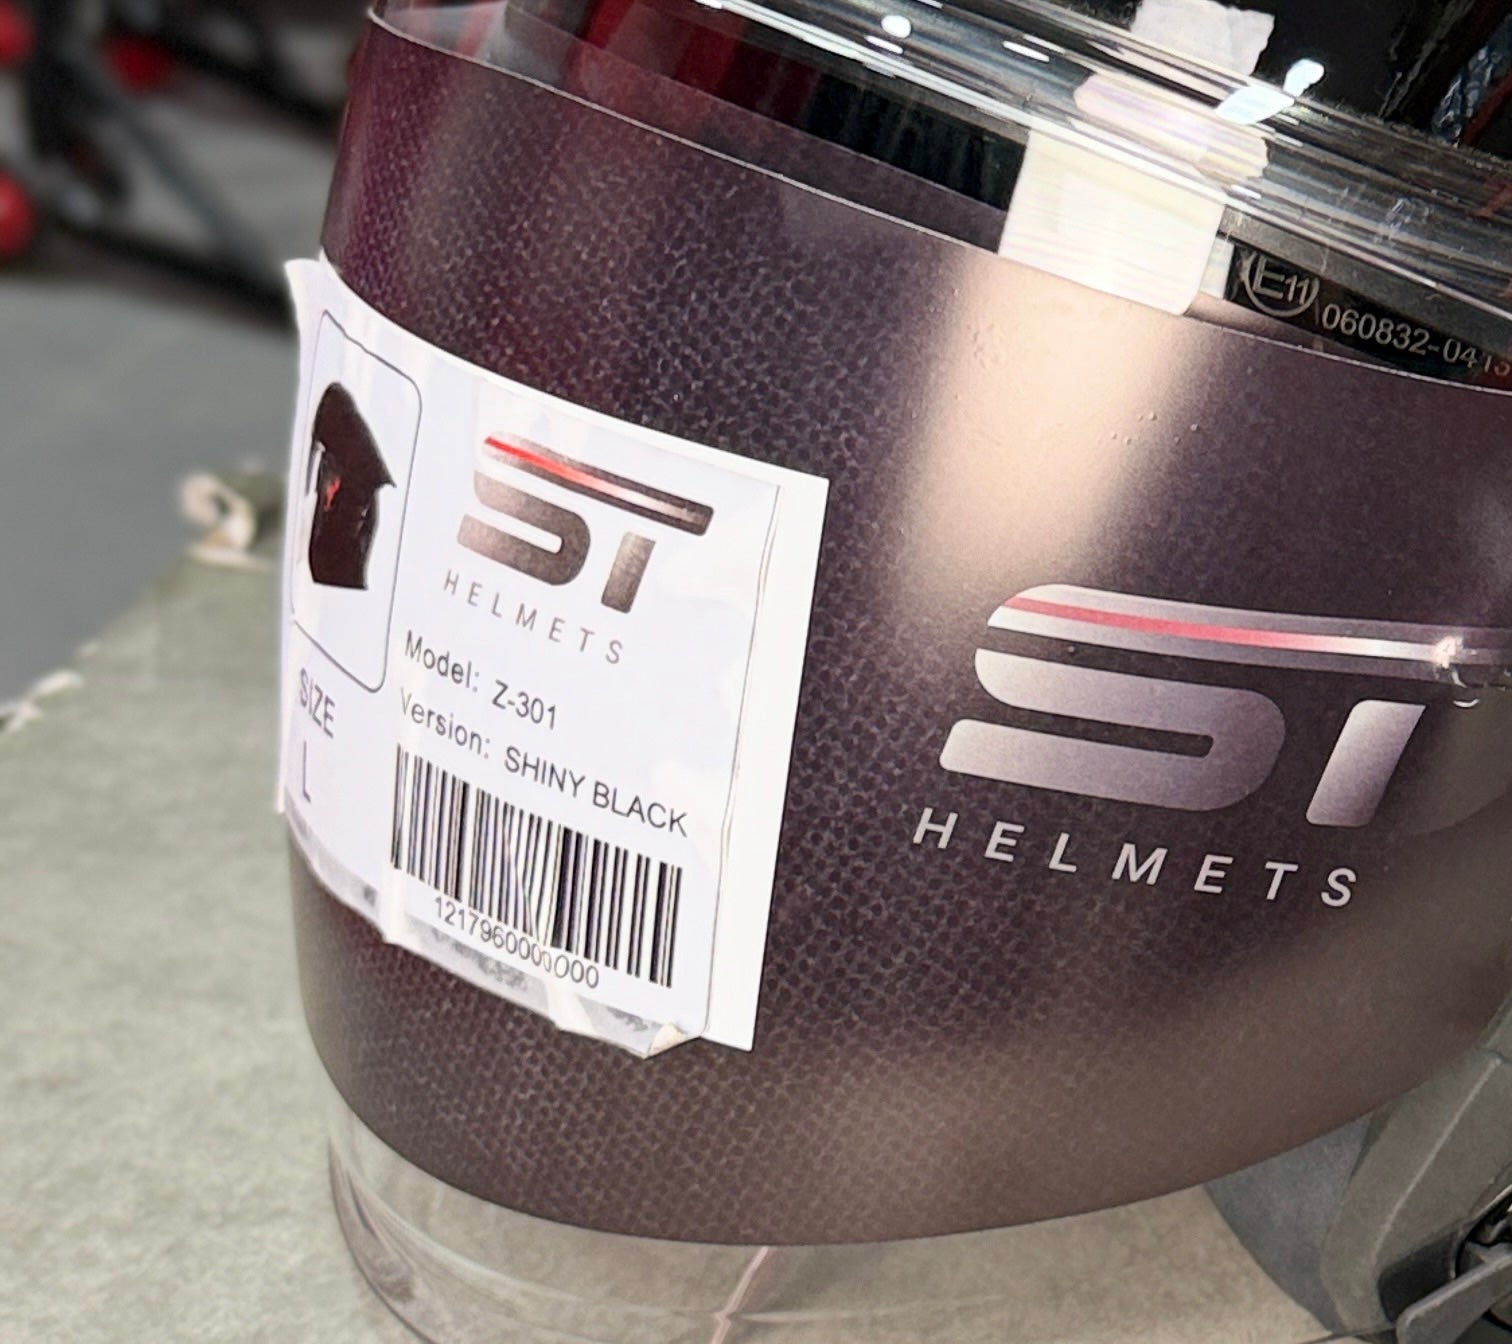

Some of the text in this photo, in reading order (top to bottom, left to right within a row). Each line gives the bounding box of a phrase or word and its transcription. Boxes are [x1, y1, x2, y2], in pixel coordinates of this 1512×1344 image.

[443, 569, 624, 665] HELMETS
[300, 668, 336, 739] SIZE
[405, 629, 557, 730] Model: Z-301
[302, 740, 312, 804] L
[400, 686, 688, 838] Version: SHINY BLACK
[912, 806, 1358, 908] HELMETS
